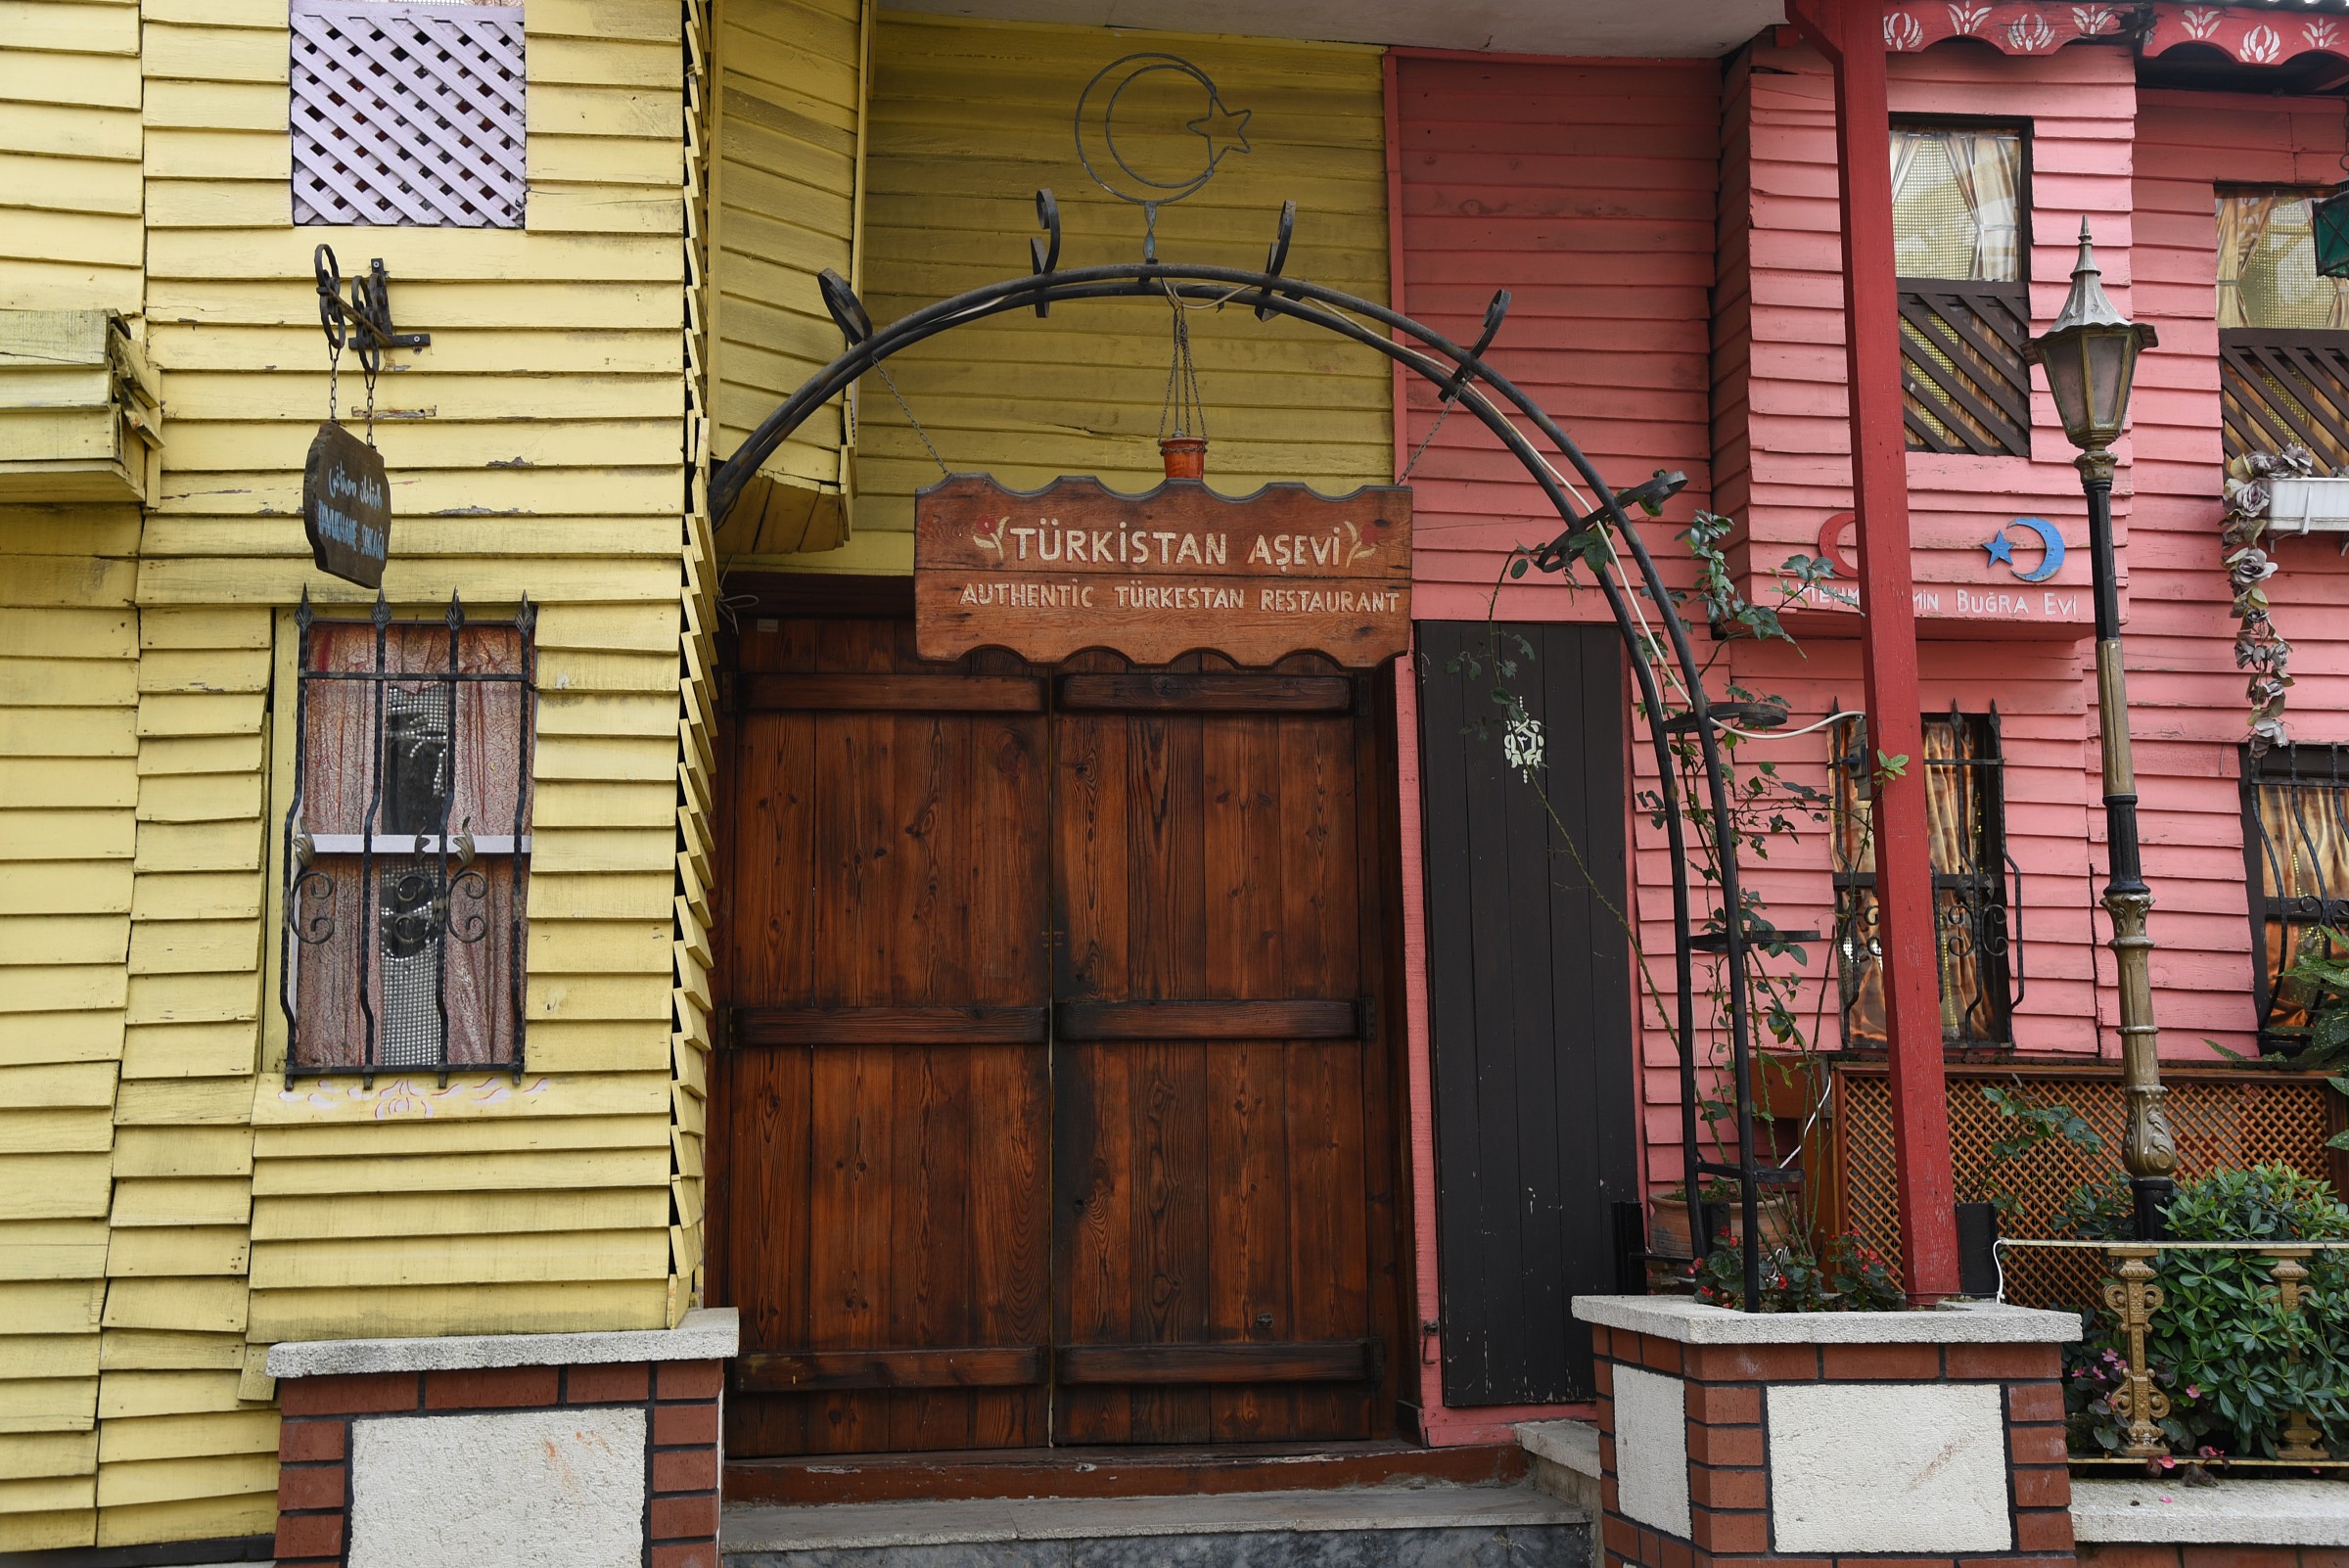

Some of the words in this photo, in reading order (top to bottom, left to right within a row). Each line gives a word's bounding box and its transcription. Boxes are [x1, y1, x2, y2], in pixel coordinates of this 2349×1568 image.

[1010, 517, 1227, 566] TÜRKİSTAN
[1246, 526, 1341, 573] AŞEVİ
[1114, 579, 1245, 610] TÜRKESTAN
[1260, 587, 1402, 615] RESTAURANT
[1957, 588, 2030, 615] BUĞRA
